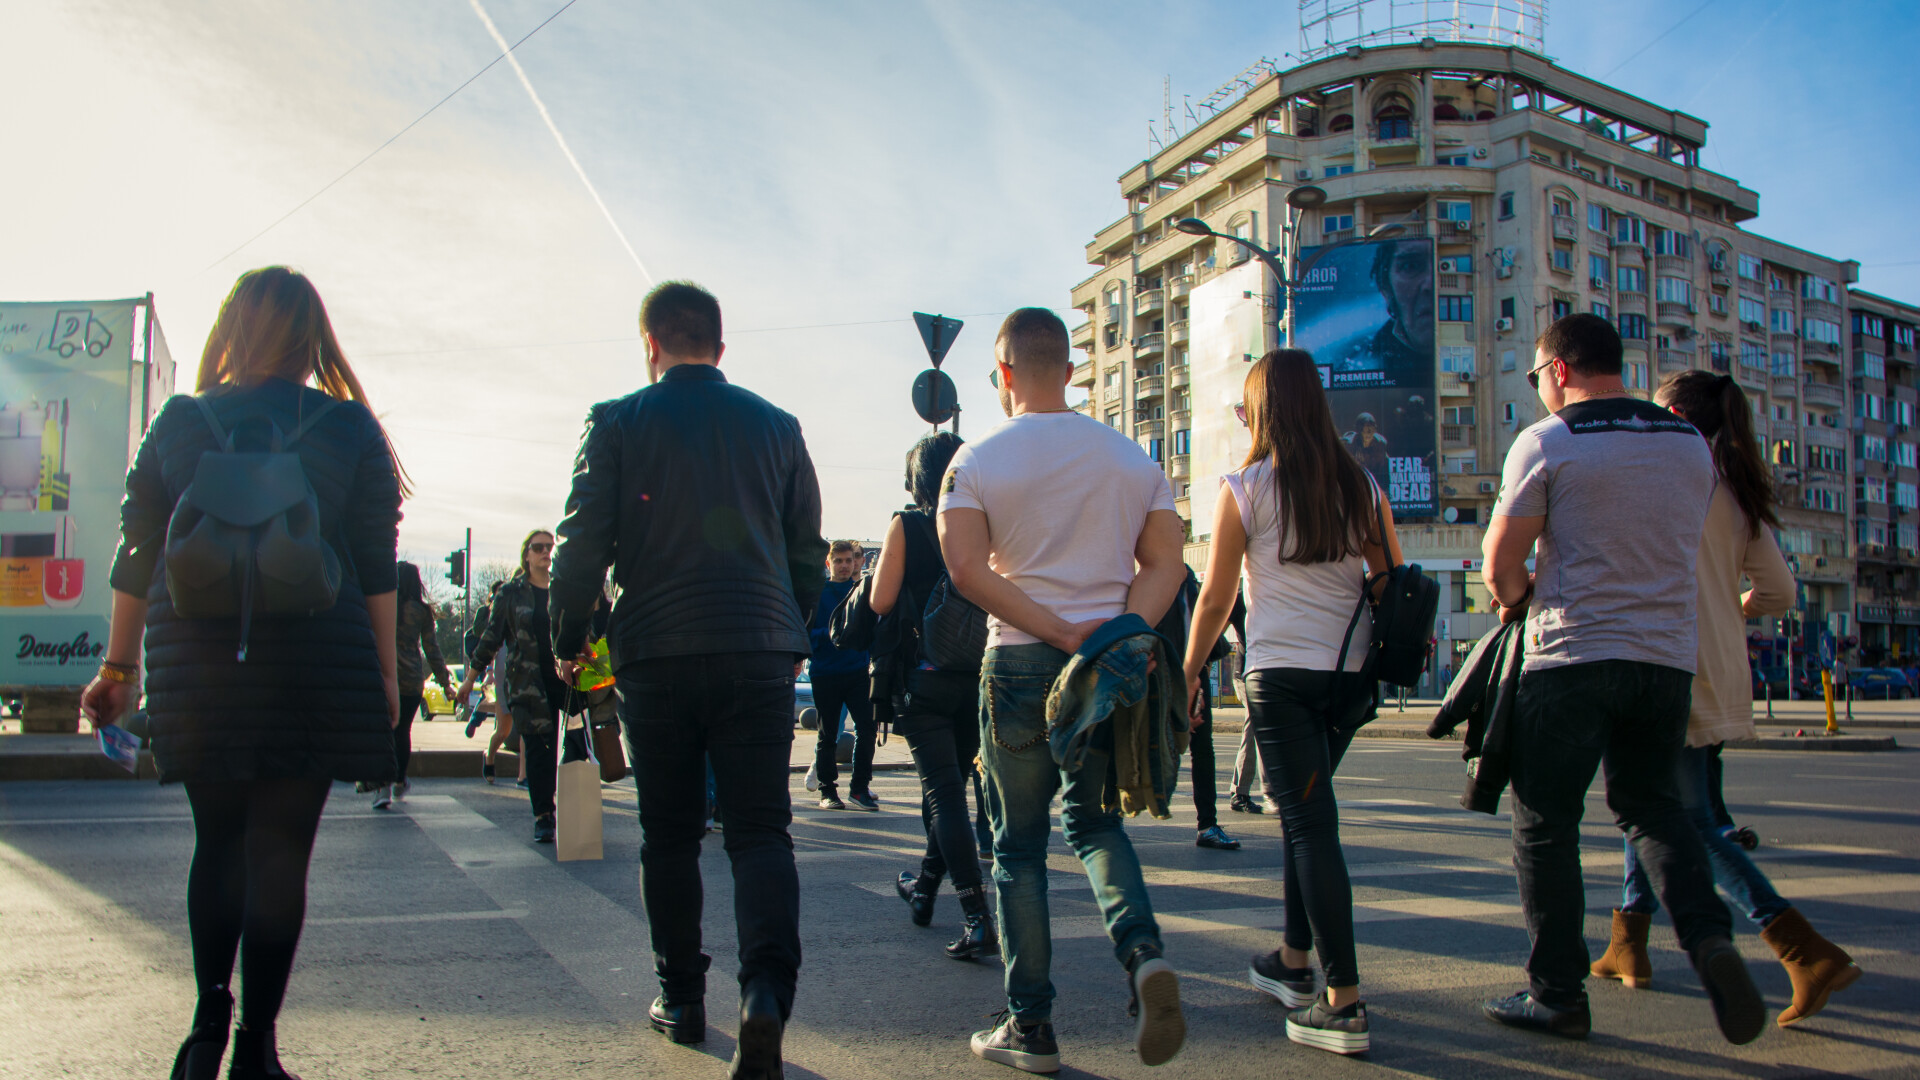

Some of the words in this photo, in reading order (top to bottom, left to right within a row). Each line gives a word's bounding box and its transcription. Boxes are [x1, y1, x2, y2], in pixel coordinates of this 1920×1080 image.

[1295, 266, 1338, 284] RROR
[1333, 371, 1385, 382] PREMIERE
[1388, 456, 1423, 473] FEAR
[1389, 472, 1431, 484] WALKING
[1388, 483, 1431, 502] DEAD
[16, 630, 104, 666] Douglas
